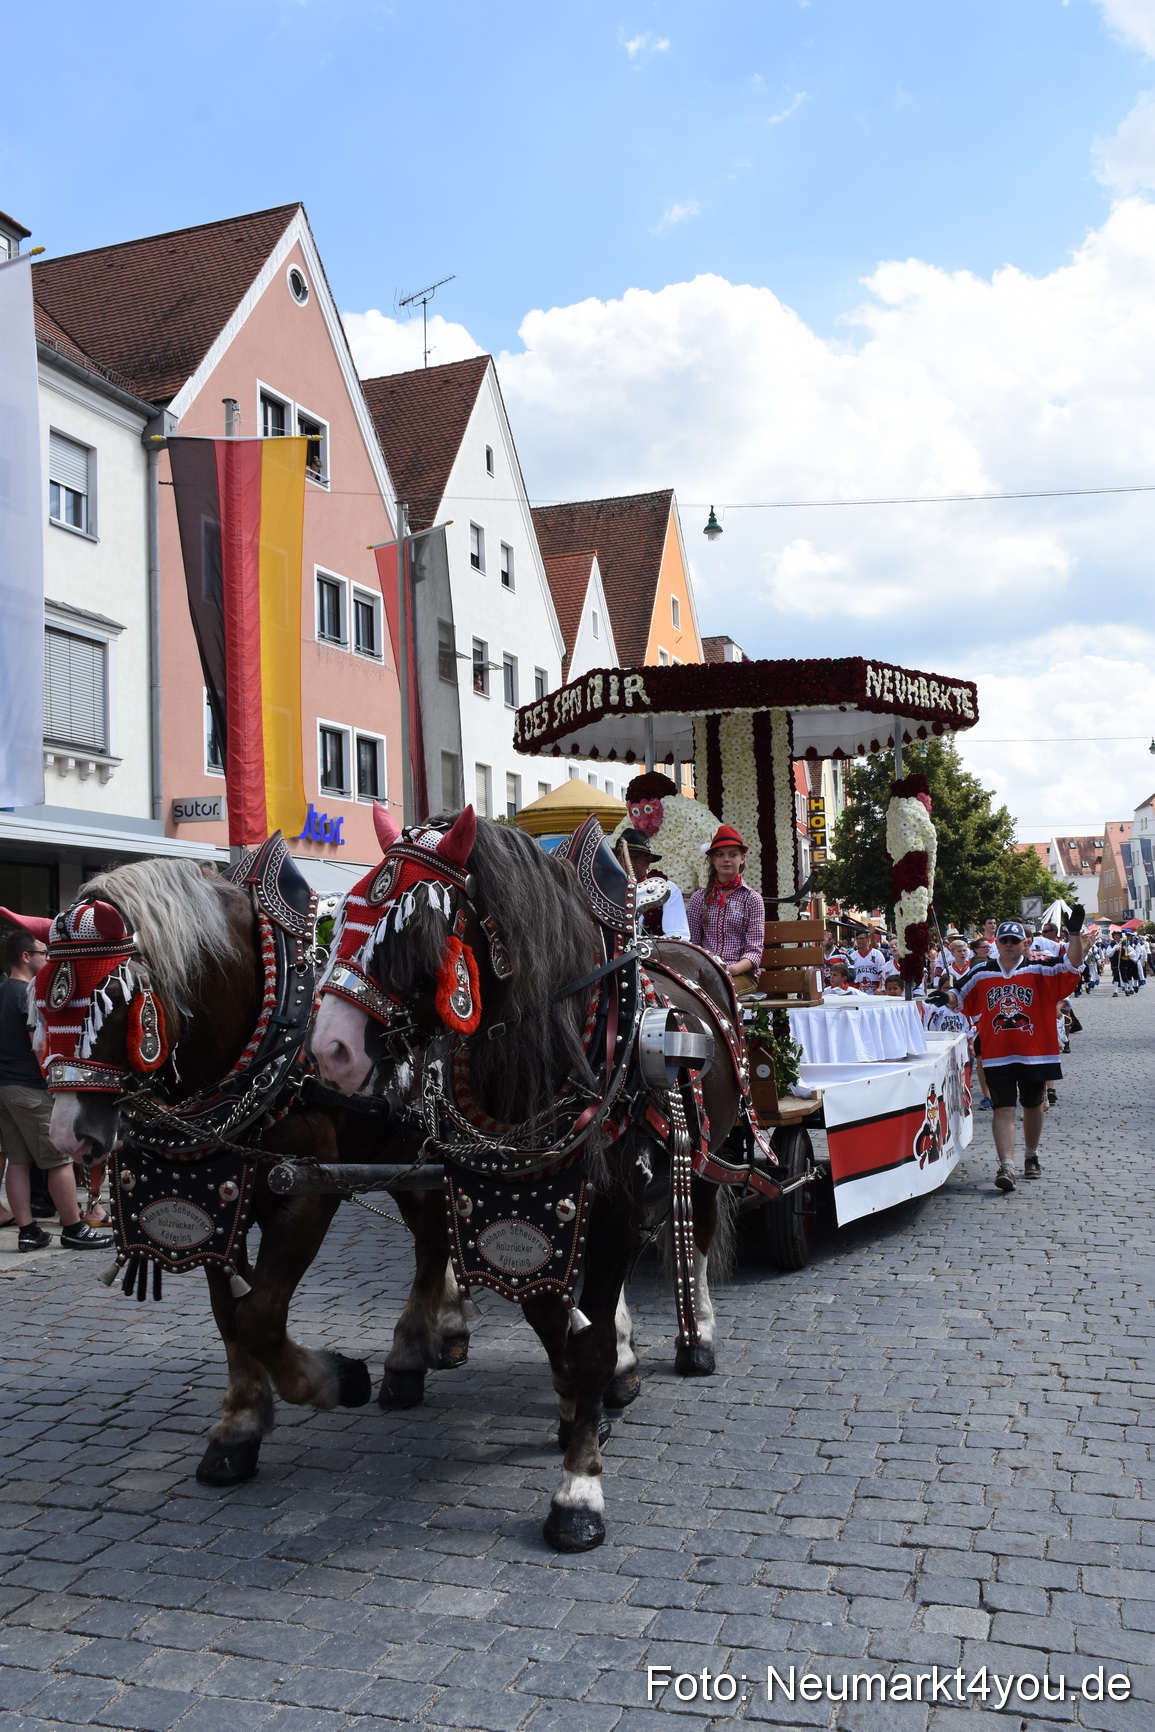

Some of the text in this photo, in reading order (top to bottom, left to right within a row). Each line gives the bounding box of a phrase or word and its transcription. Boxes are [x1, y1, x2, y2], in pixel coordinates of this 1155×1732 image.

[297, 803, 345, 845] tor.
[811, 798, 826, 880] HOTE
[1002, 924, 1019, 933] 76
[986, 984, 1033, 1011] Eagles
[158, 1218, 195, 1230] Holzrücker
[496, 1242, 533, 1253] Holzrücker
